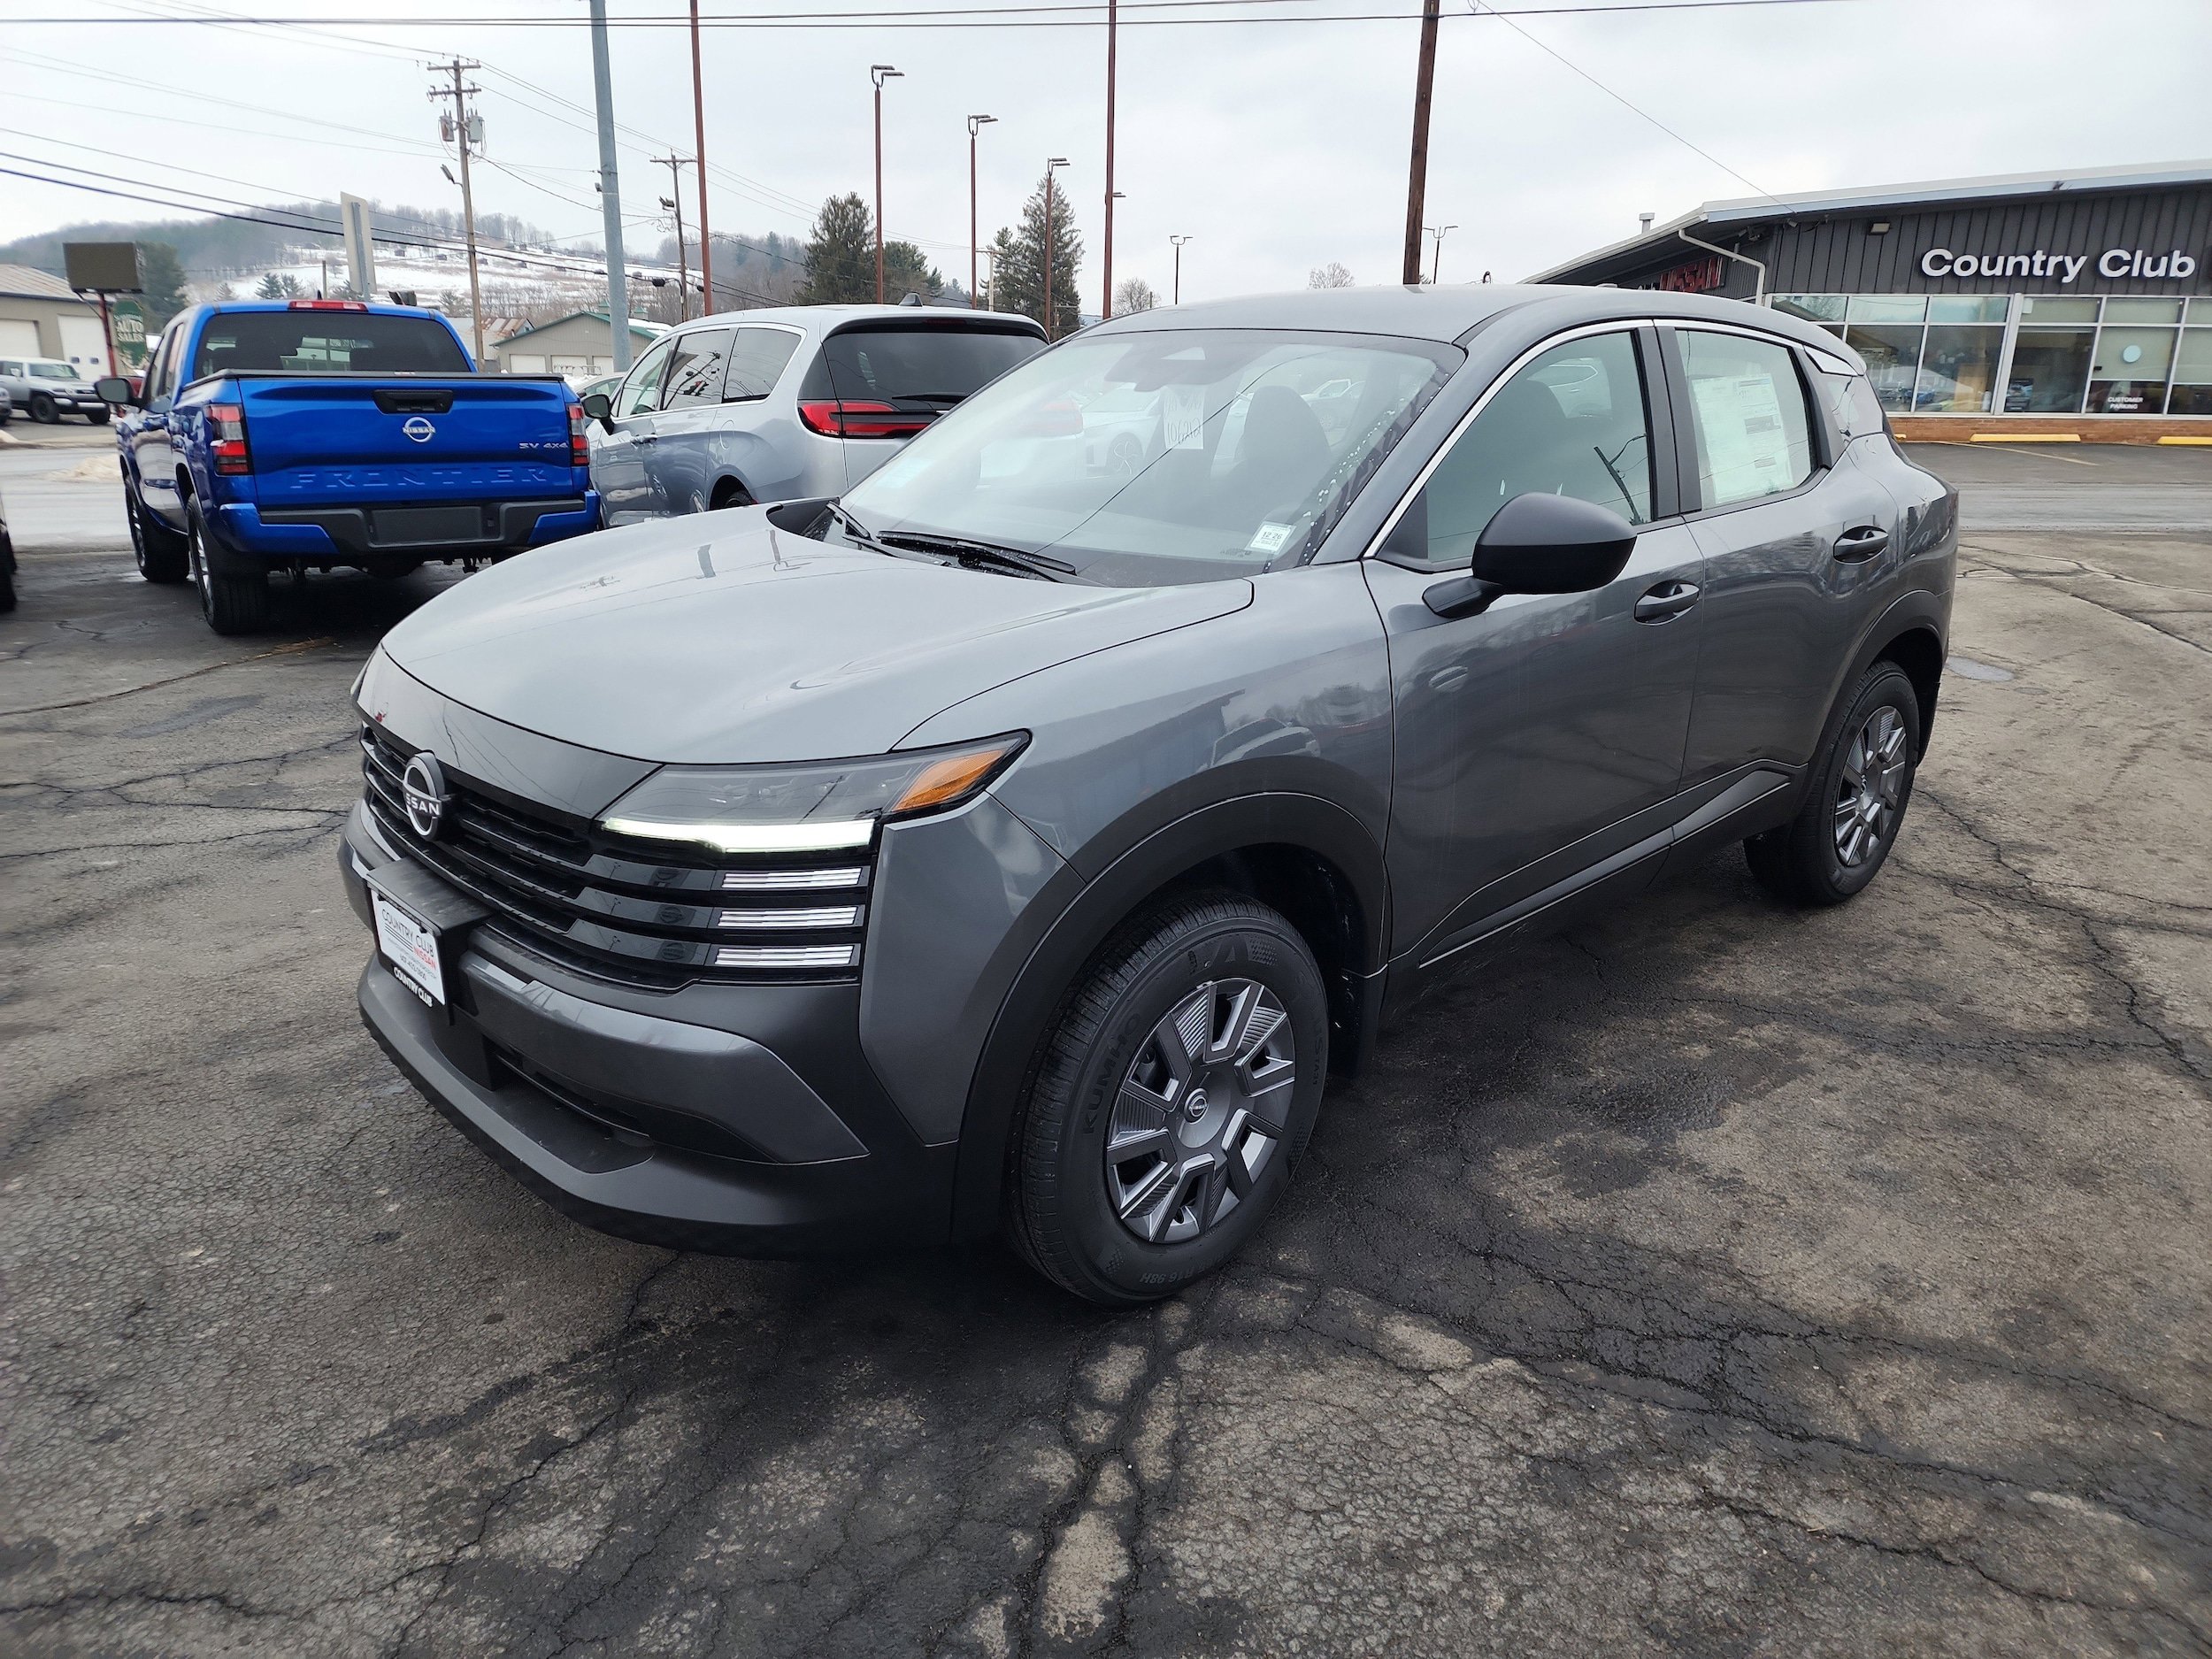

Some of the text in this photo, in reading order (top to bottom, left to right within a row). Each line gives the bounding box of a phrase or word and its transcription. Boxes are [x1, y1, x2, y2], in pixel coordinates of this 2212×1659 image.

[1921, 248, 2196, 283] Country Club
[116, 318, 144, 333] AUTO
[117, 332, 145, 342] SALES
[288, 467, 547, 489] FRONTIER
[381, 909, 434, 957] COUNTRY CLUB
[394, 966, 419, 995] COUNTRY
[418, 987, 433, 1008] CLUB
[1082, 1012, 1141, 1134] KUMHO
